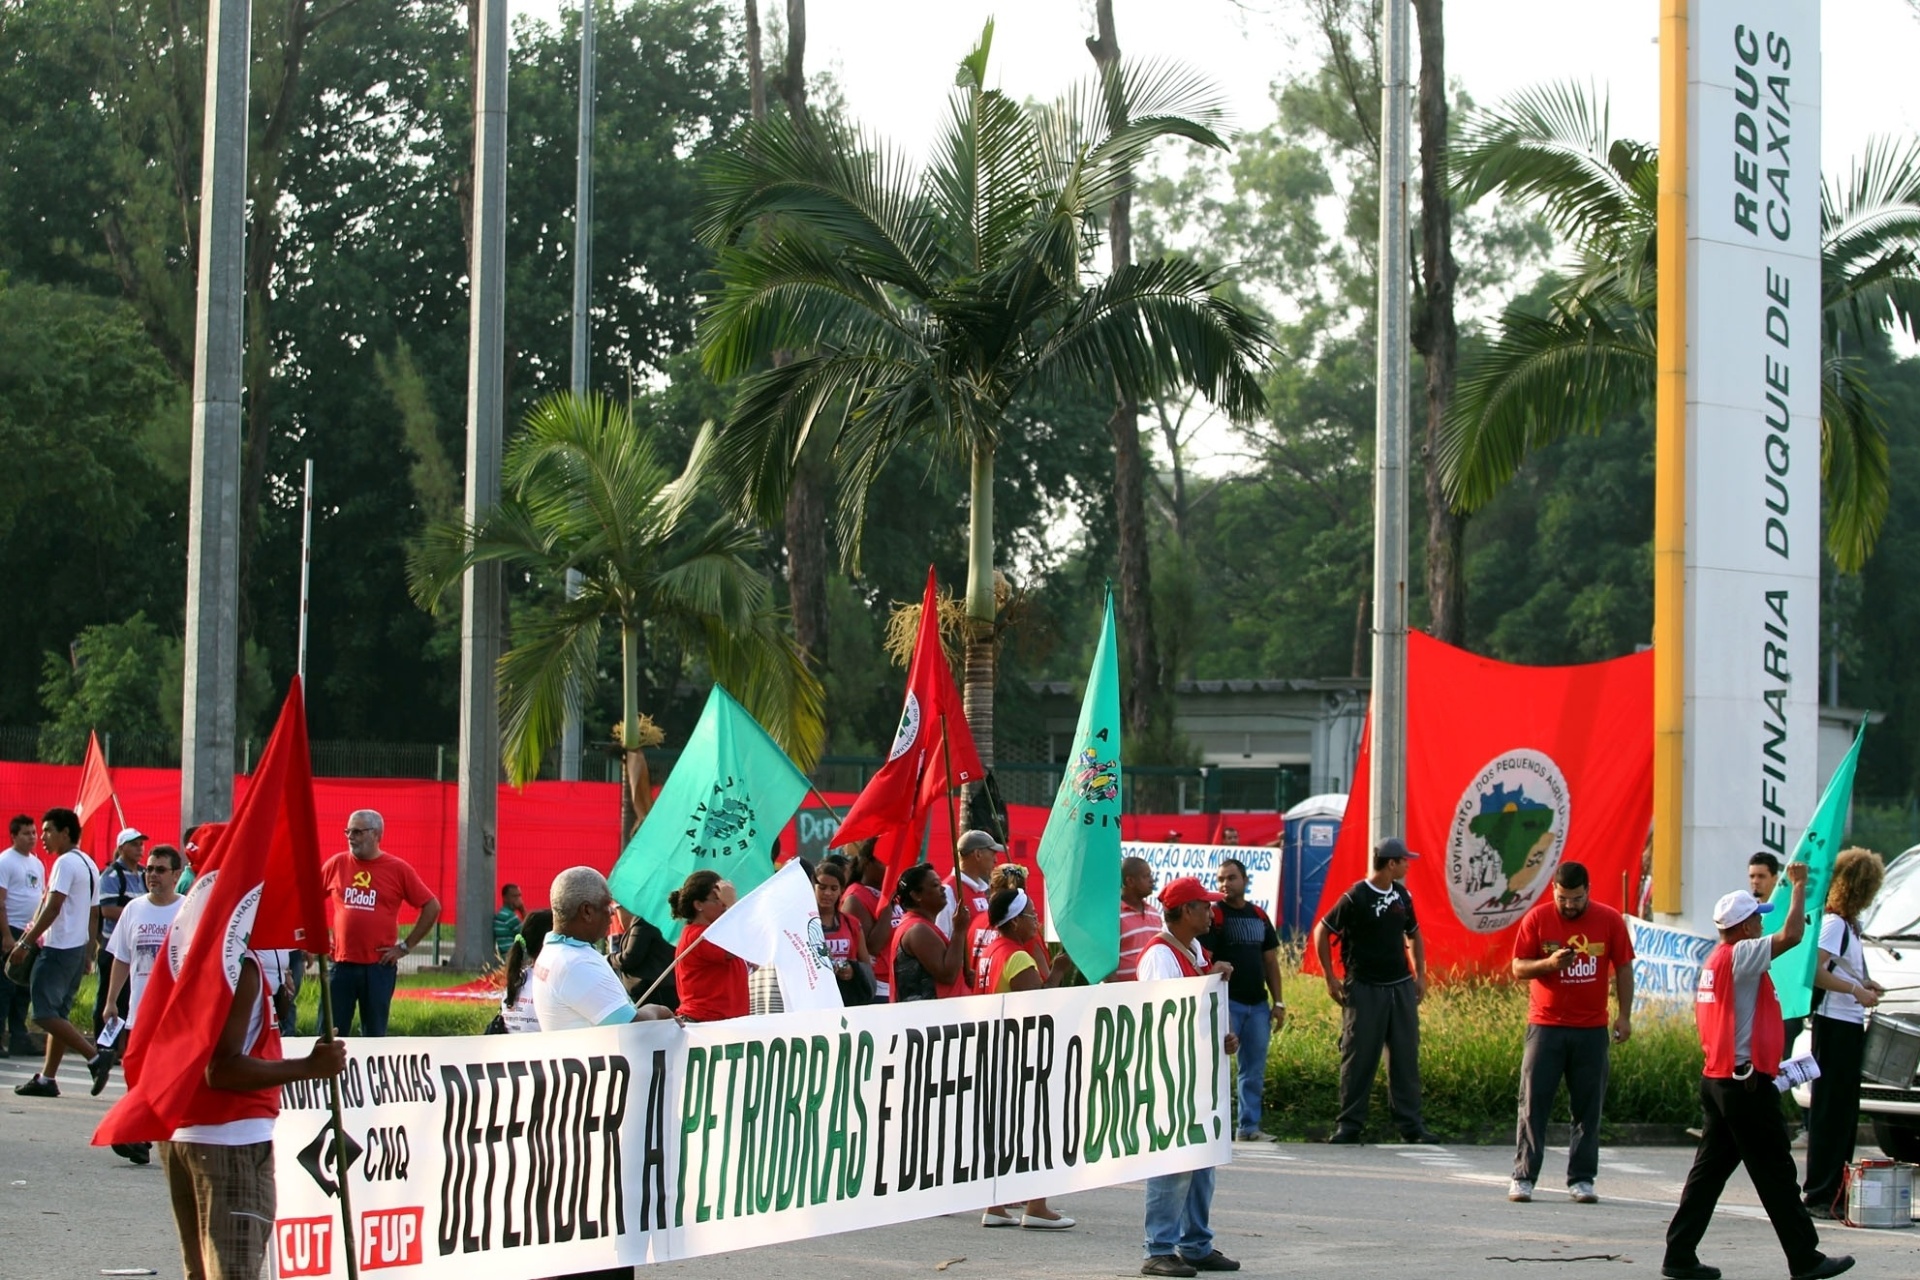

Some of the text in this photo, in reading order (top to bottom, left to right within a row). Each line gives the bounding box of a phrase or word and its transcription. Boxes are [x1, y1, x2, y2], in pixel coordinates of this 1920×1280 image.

[1735, 24, 1759, 237] REDUC
[1762, 31, 1791, 866] EFINARIA DUQUE DE CAXIAS
[892, 725, 917, 757] TRABALHAD
[1453, 800, 1473, 885] MOVIMENTO
[1476, 770, 1494, 793] DOS
[1497, 757, 1547, 778] PEQUENOS
[1183, 848, 1204, 868] DOS
[344, 887, 377, 906] PCdoB
[1478, 913, 1513, 930] Brasil
[278, 1053, 437, 1111] NDIPERO CAXIAS
[364, 1125, 410, 1182] CNQ
[438, 1055, 631, 1256] DEFENDER
[640, 1049, 667, 1232] A
[873, 1034, 899, 1196] É
[898, 1014, 1055, 1192] DEFENDER
[1062, 1034, 1083, 1168] O
[279, 1222, 330, 1271] CUT
[363, 1213, 417, 1265] FUP
